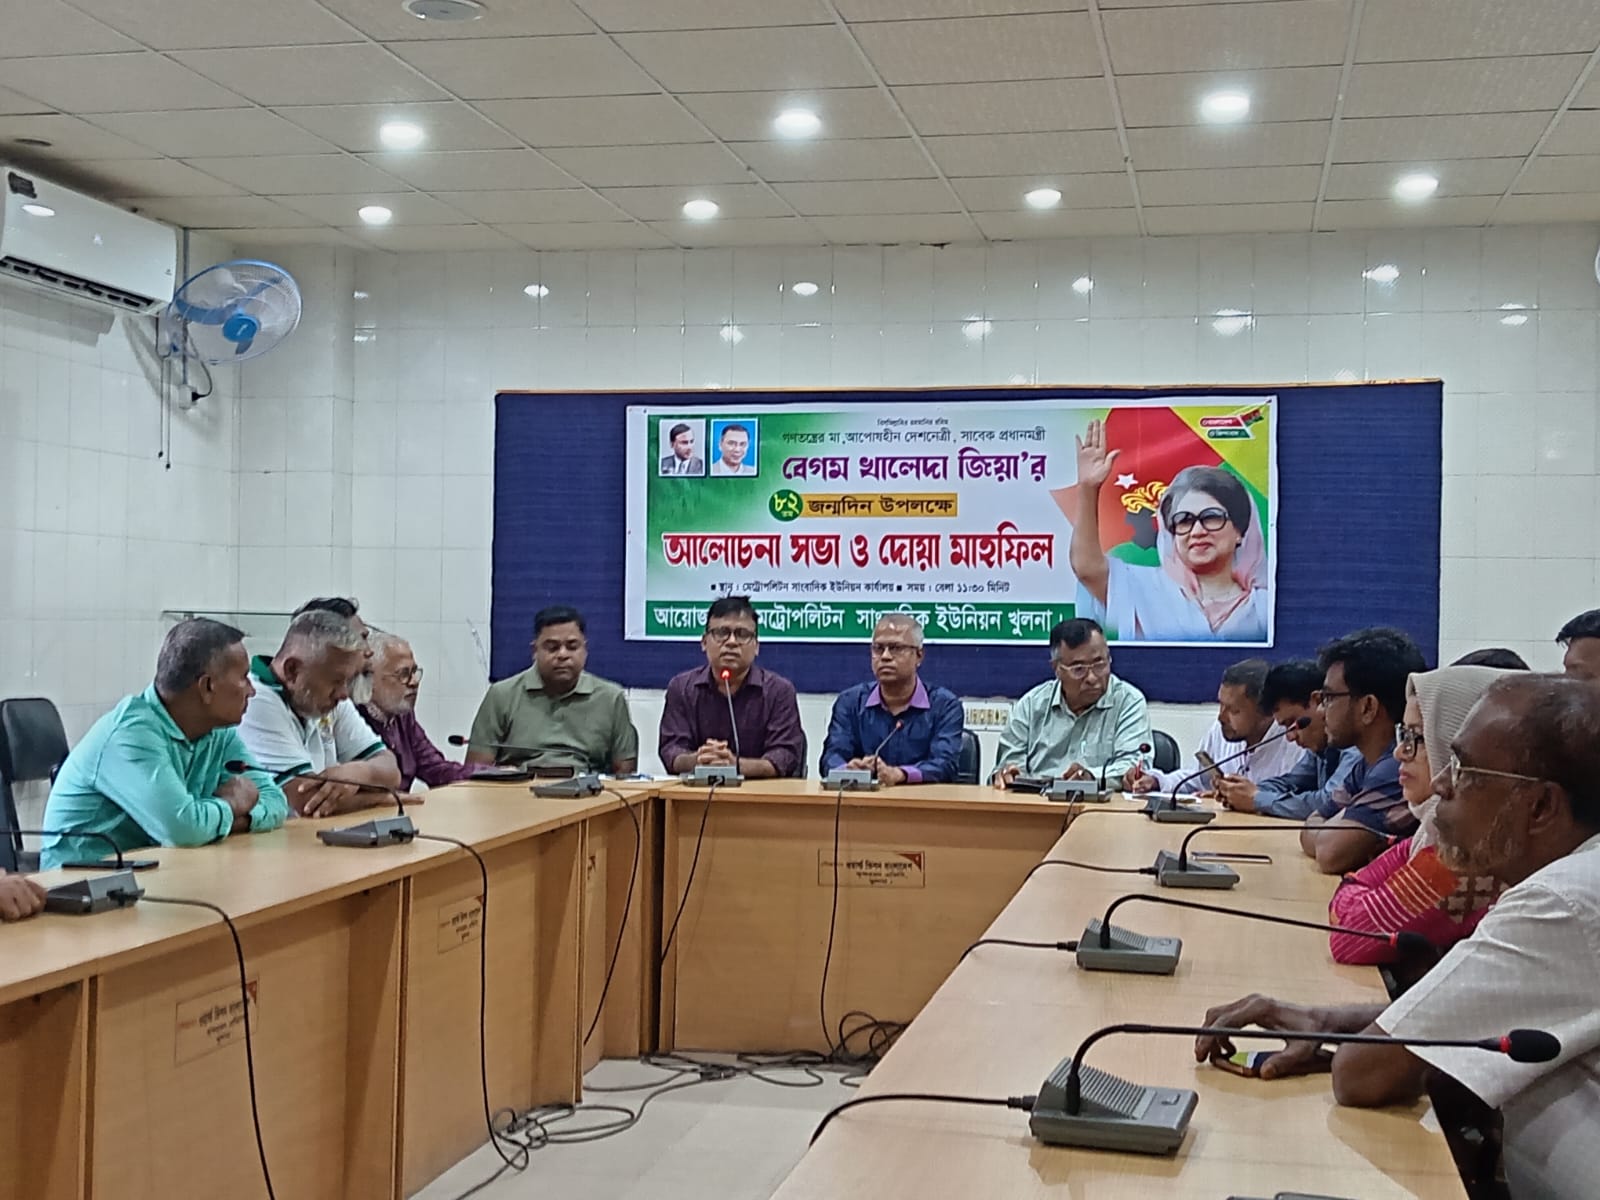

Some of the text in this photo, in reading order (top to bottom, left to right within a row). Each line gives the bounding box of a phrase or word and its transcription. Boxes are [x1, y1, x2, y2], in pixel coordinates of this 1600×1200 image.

[960, 430, 995, 442] সাবেক
[998, 425, 1046, 442] প্রধানমন্ত্রী
[782, 455, 850, 481] বেগম
[858, 454, 949, 481] খালেদা
[774, 491, 954, 516] ৮২ জন্মদিন উপলক্ষে
[662, 522, 1055, 572] আলোচনা সভা ও দোয়া মাহফিল
[829, 580, 862, 593] ইউনিয়ন
[934, 582, 955, 593] বেলা
[986, 580, 1010, 593] মিনিট
[934, 604, 1003, 632] ইউনিয়ন
[1007, 607, 1053, 636] খুলনা
